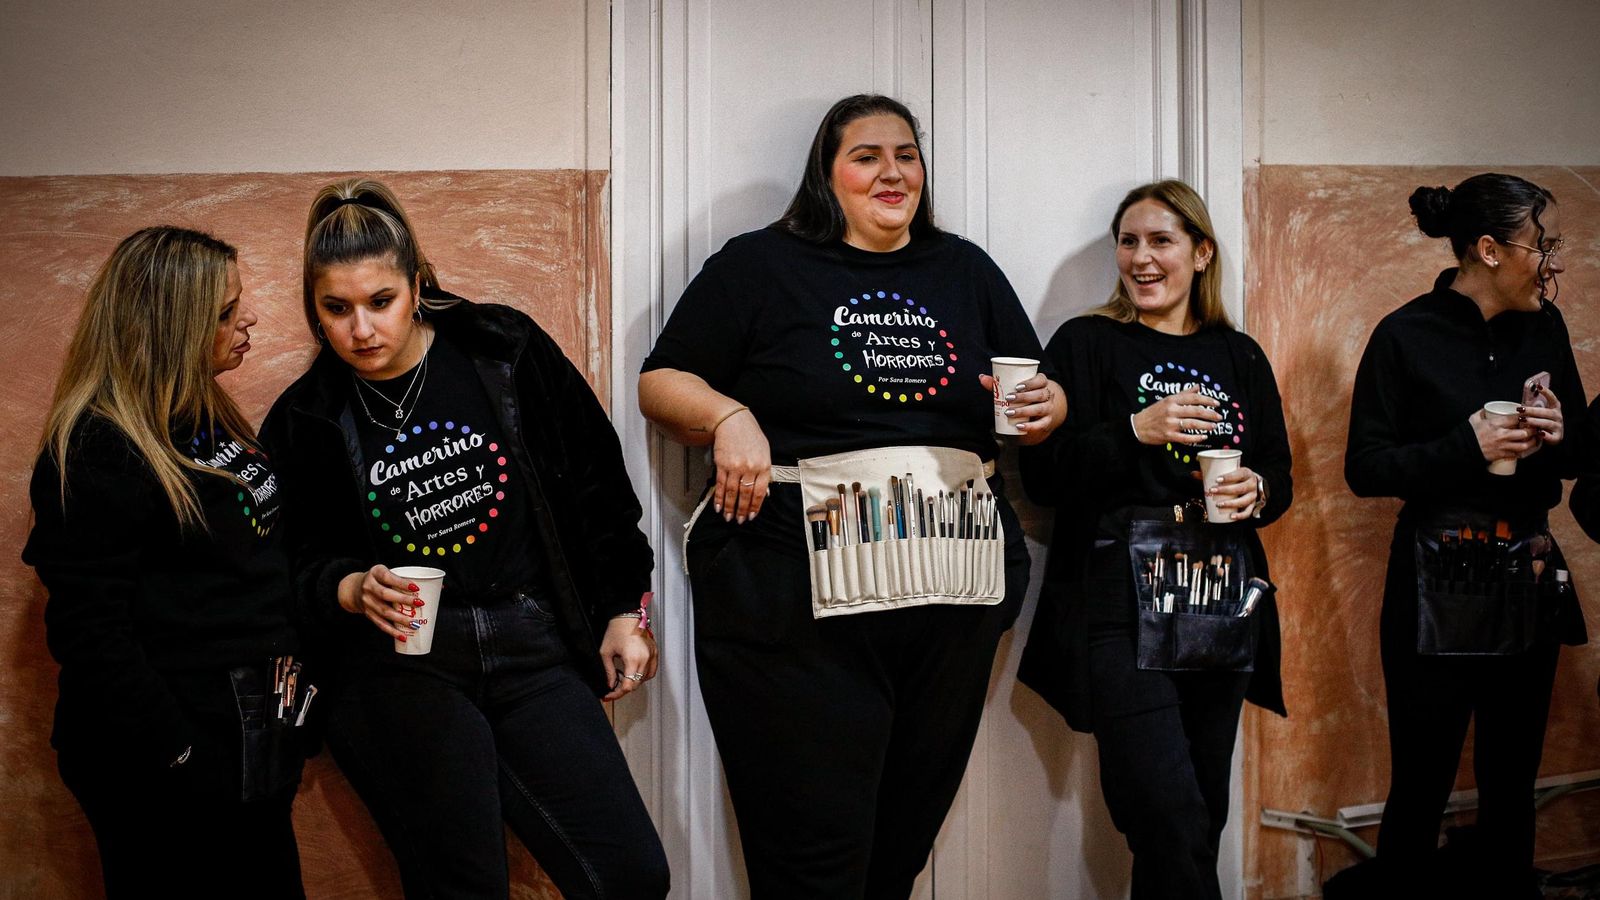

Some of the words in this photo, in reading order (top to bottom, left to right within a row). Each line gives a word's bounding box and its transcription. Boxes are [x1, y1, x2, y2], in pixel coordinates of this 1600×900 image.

[833, 305, 938, 328] Camerino
[865, 331, 921, 349] Artes
[862, 349, 945, 369] HORRORES
[370, 433, 486, 486] Camerino
[390, 486, 401, 496] de
[406, 466, 468, 502] Artes
[404, 481, 493, 531] HORRORES
[427, 532, 438, 540] Por
[438, 526, 453, 536] Sara
[453, 517, 476, 531] Romero
